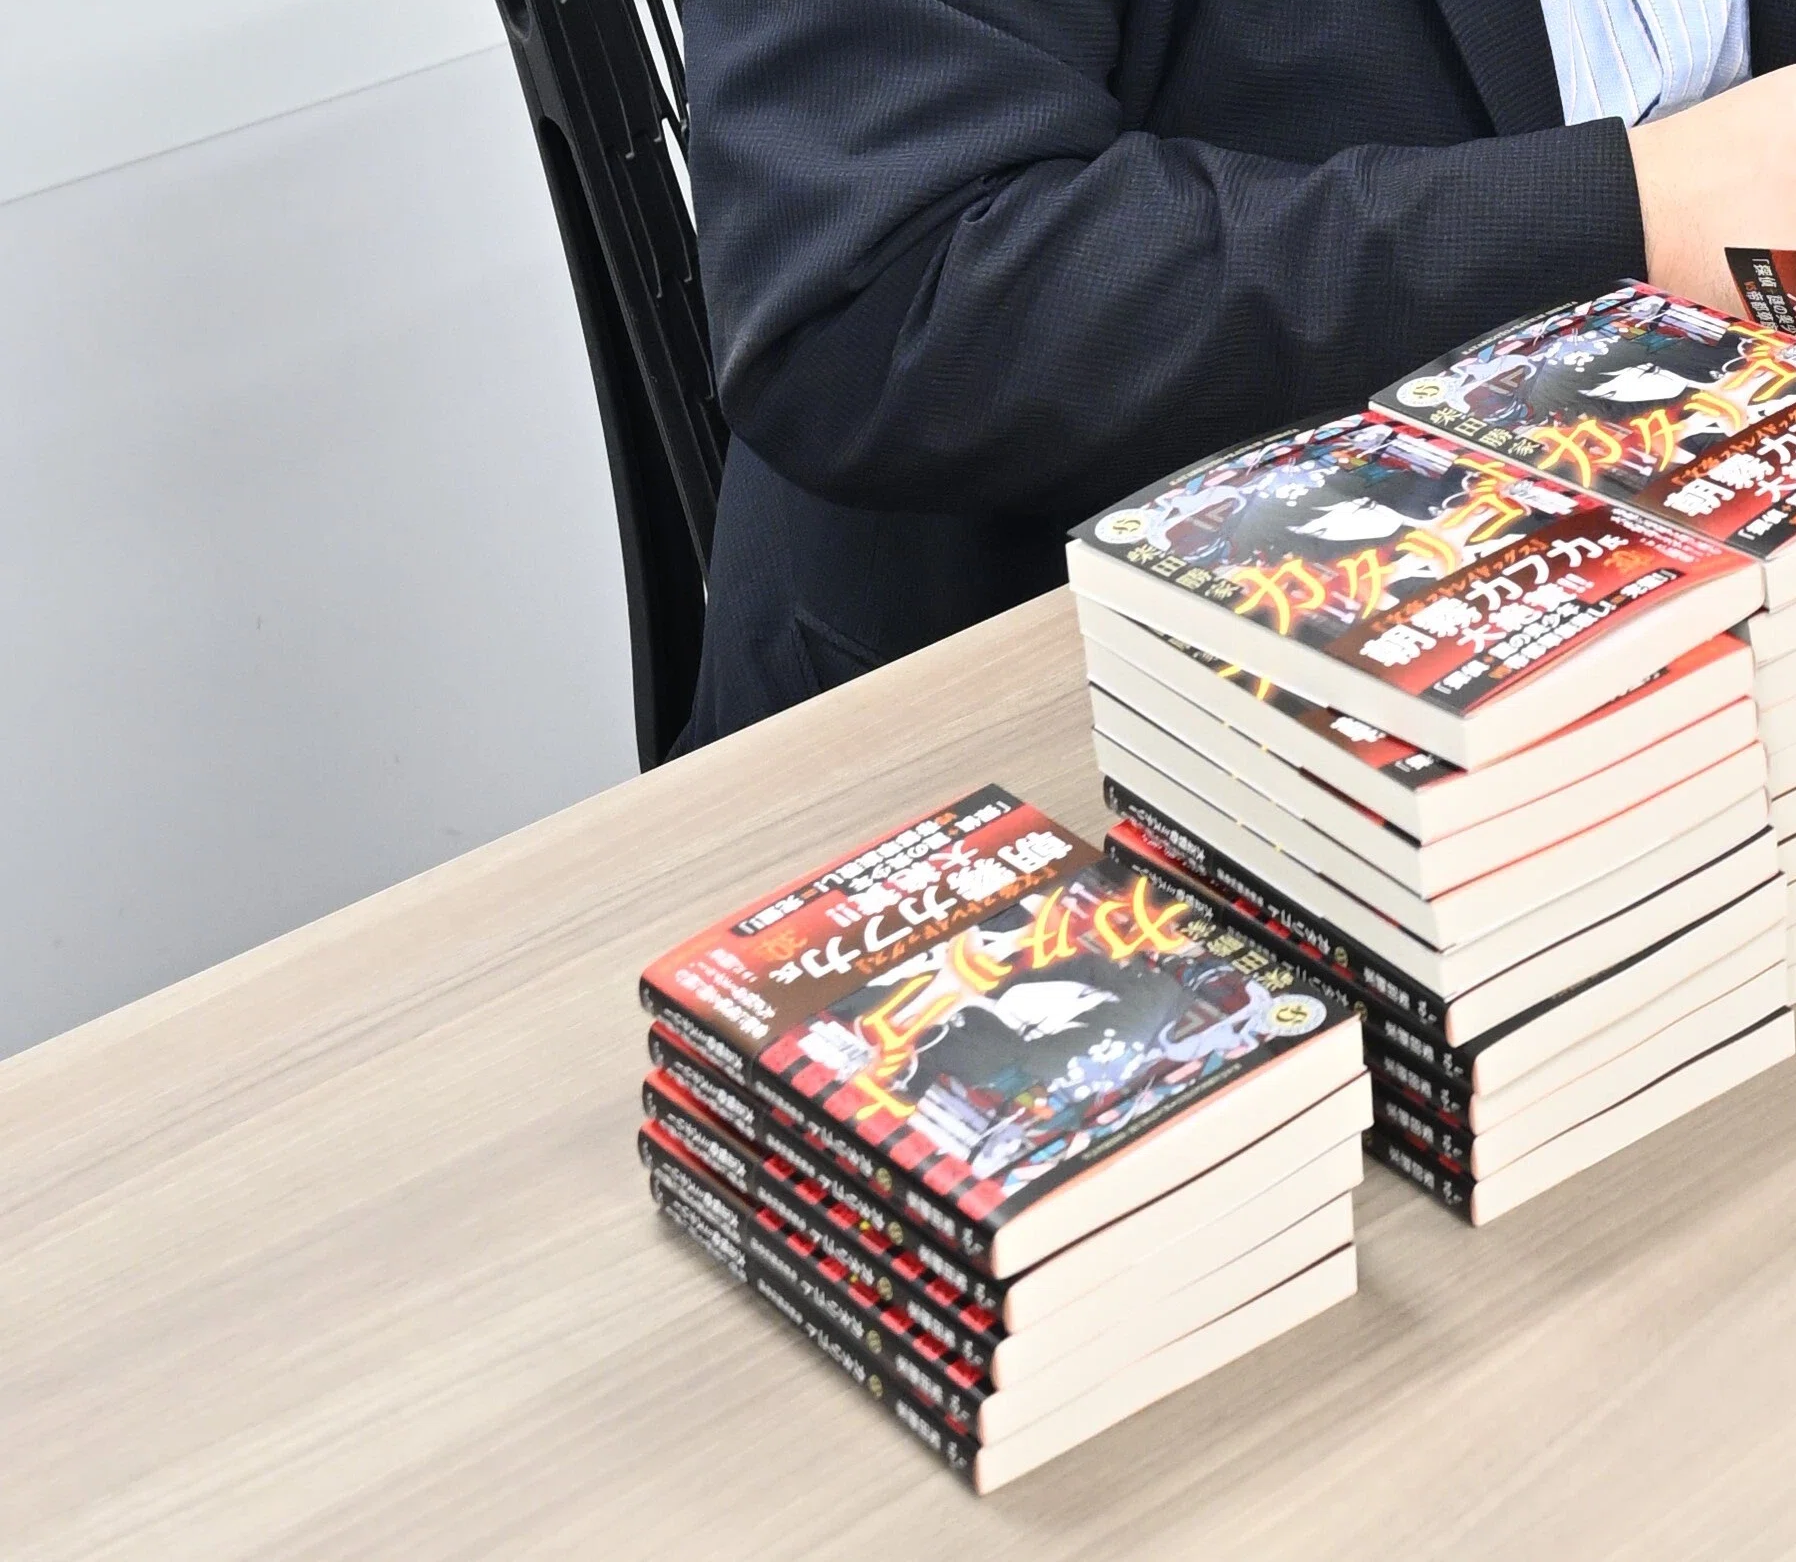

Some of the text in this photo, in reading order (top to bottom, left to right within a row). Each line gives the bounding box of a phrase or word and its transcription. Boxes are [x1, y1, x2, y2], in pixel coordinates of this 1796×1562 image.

[1430, 407, 1544, 456] 柴田勝家
[1234, 457, 1525, 635] カタリゴト
[855, 876, 1188, 1119] カタリゴト
